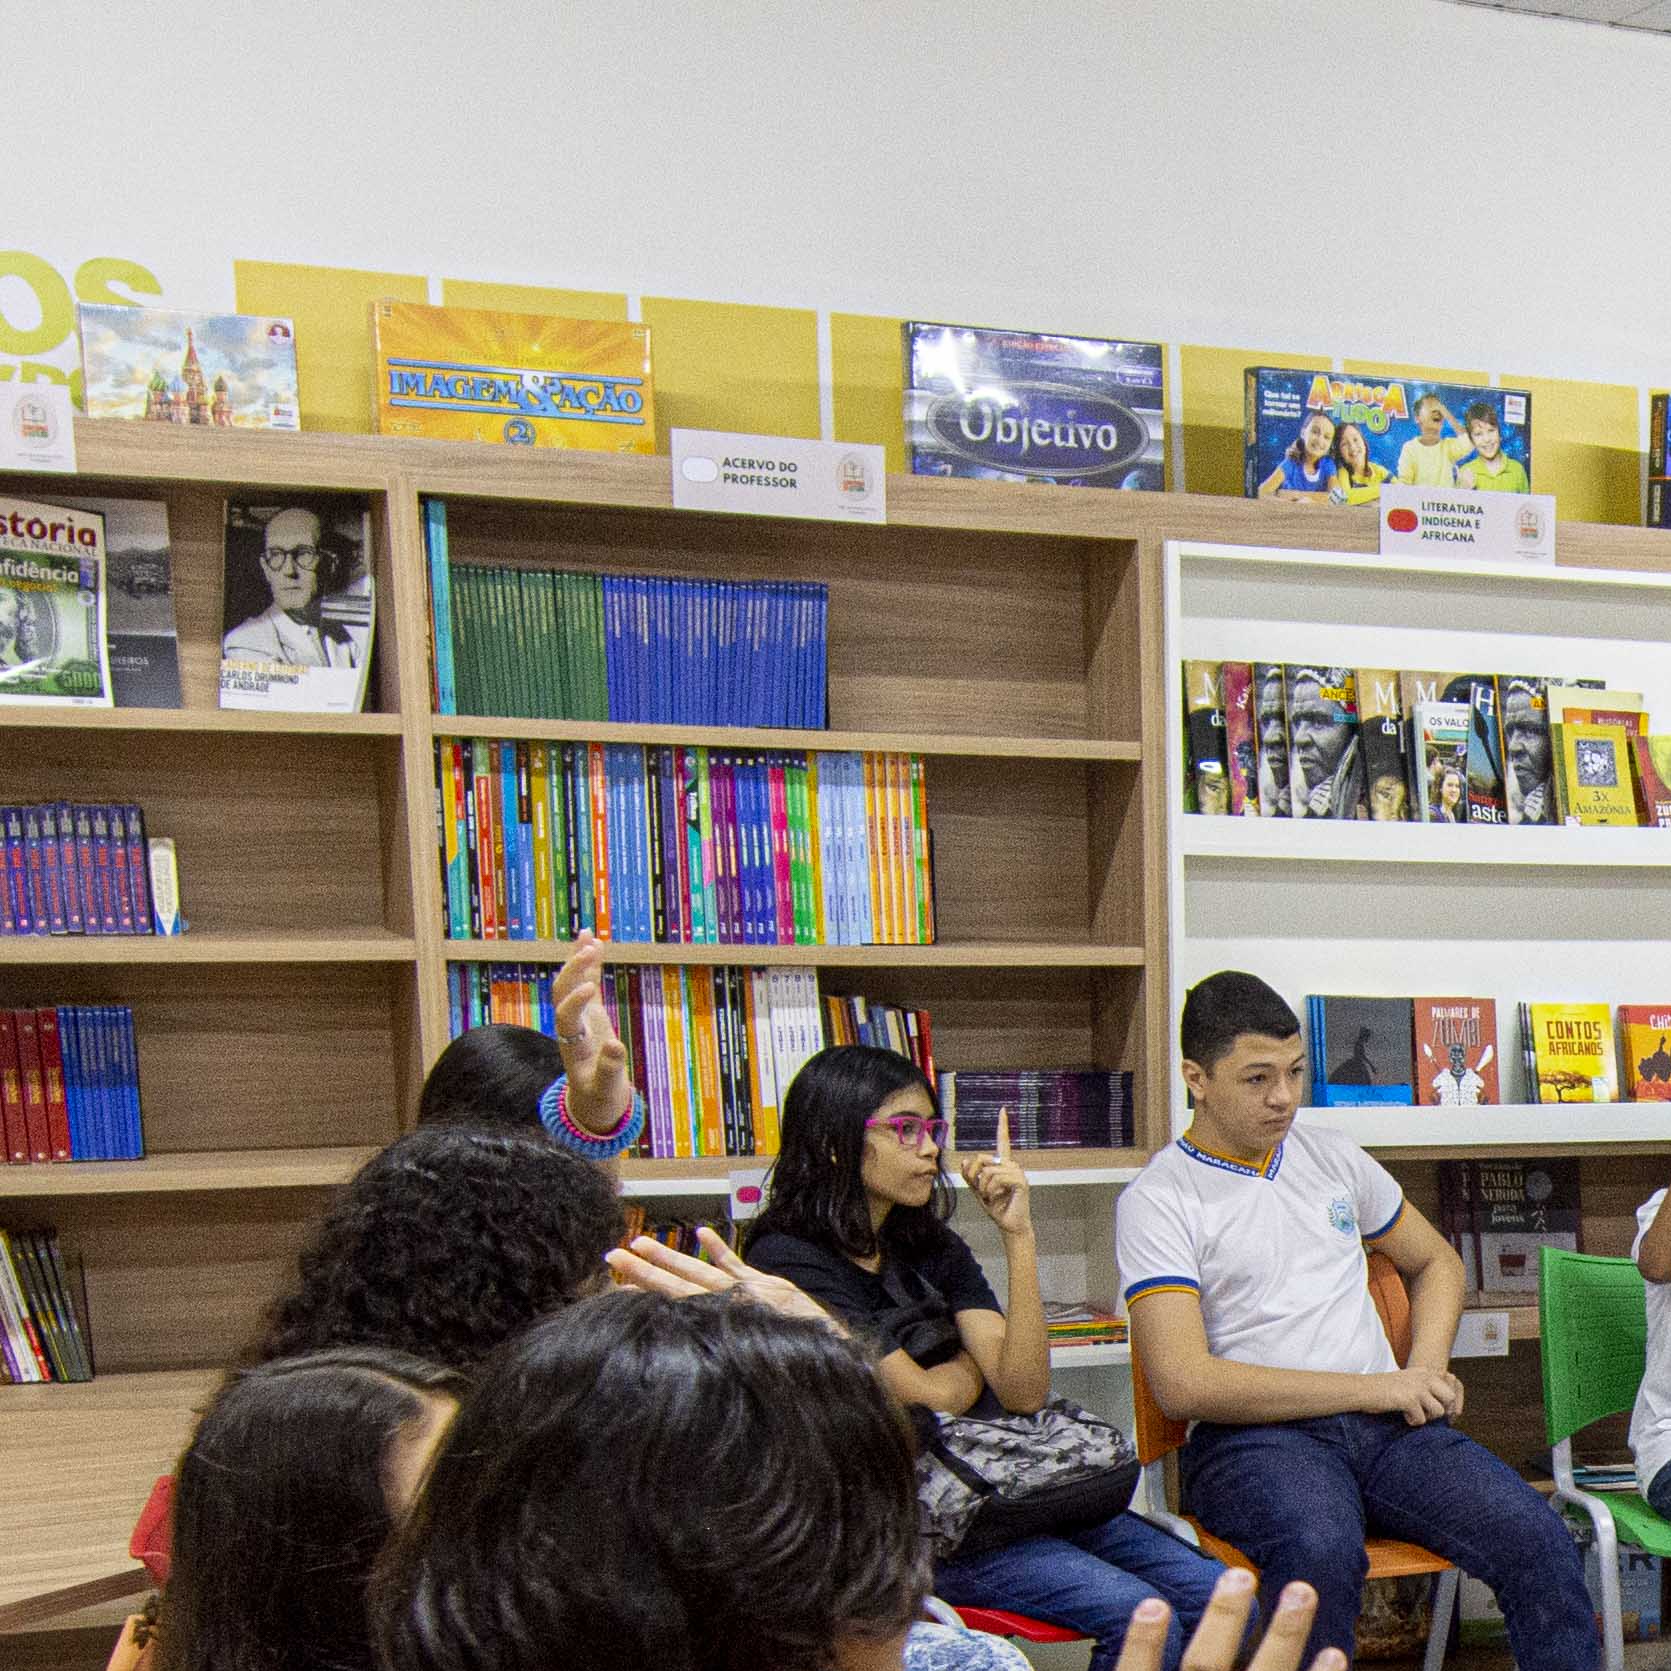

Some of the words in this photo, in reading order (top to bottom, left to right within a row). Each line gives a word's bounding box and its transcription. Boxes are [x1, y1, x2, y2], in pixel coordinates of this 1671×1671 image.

[389, 370, 524, 405] IMAGEM
[557, 380, 644, 416] AÇÃO
[959, 391, 1119, 457] Objetivo
[722, 457, 775, 472] ACERVO
[778, 461, 799, 474] DO
[723, 472, 799, 490] PROFESSOR
[1421, 501, 1485, 516] LITERATURA
[1473, 518, 1481, 530] E
[1420, 529, 1476, 544] AFRICANA
[1429, 716, 1442, 727] OS
[1546, 1020, 1602, 1041] CONTOS
[1548, 1041, 1604, 1057] AFRICANOS
[1480, 1171, 1524, 1188] PABLO
